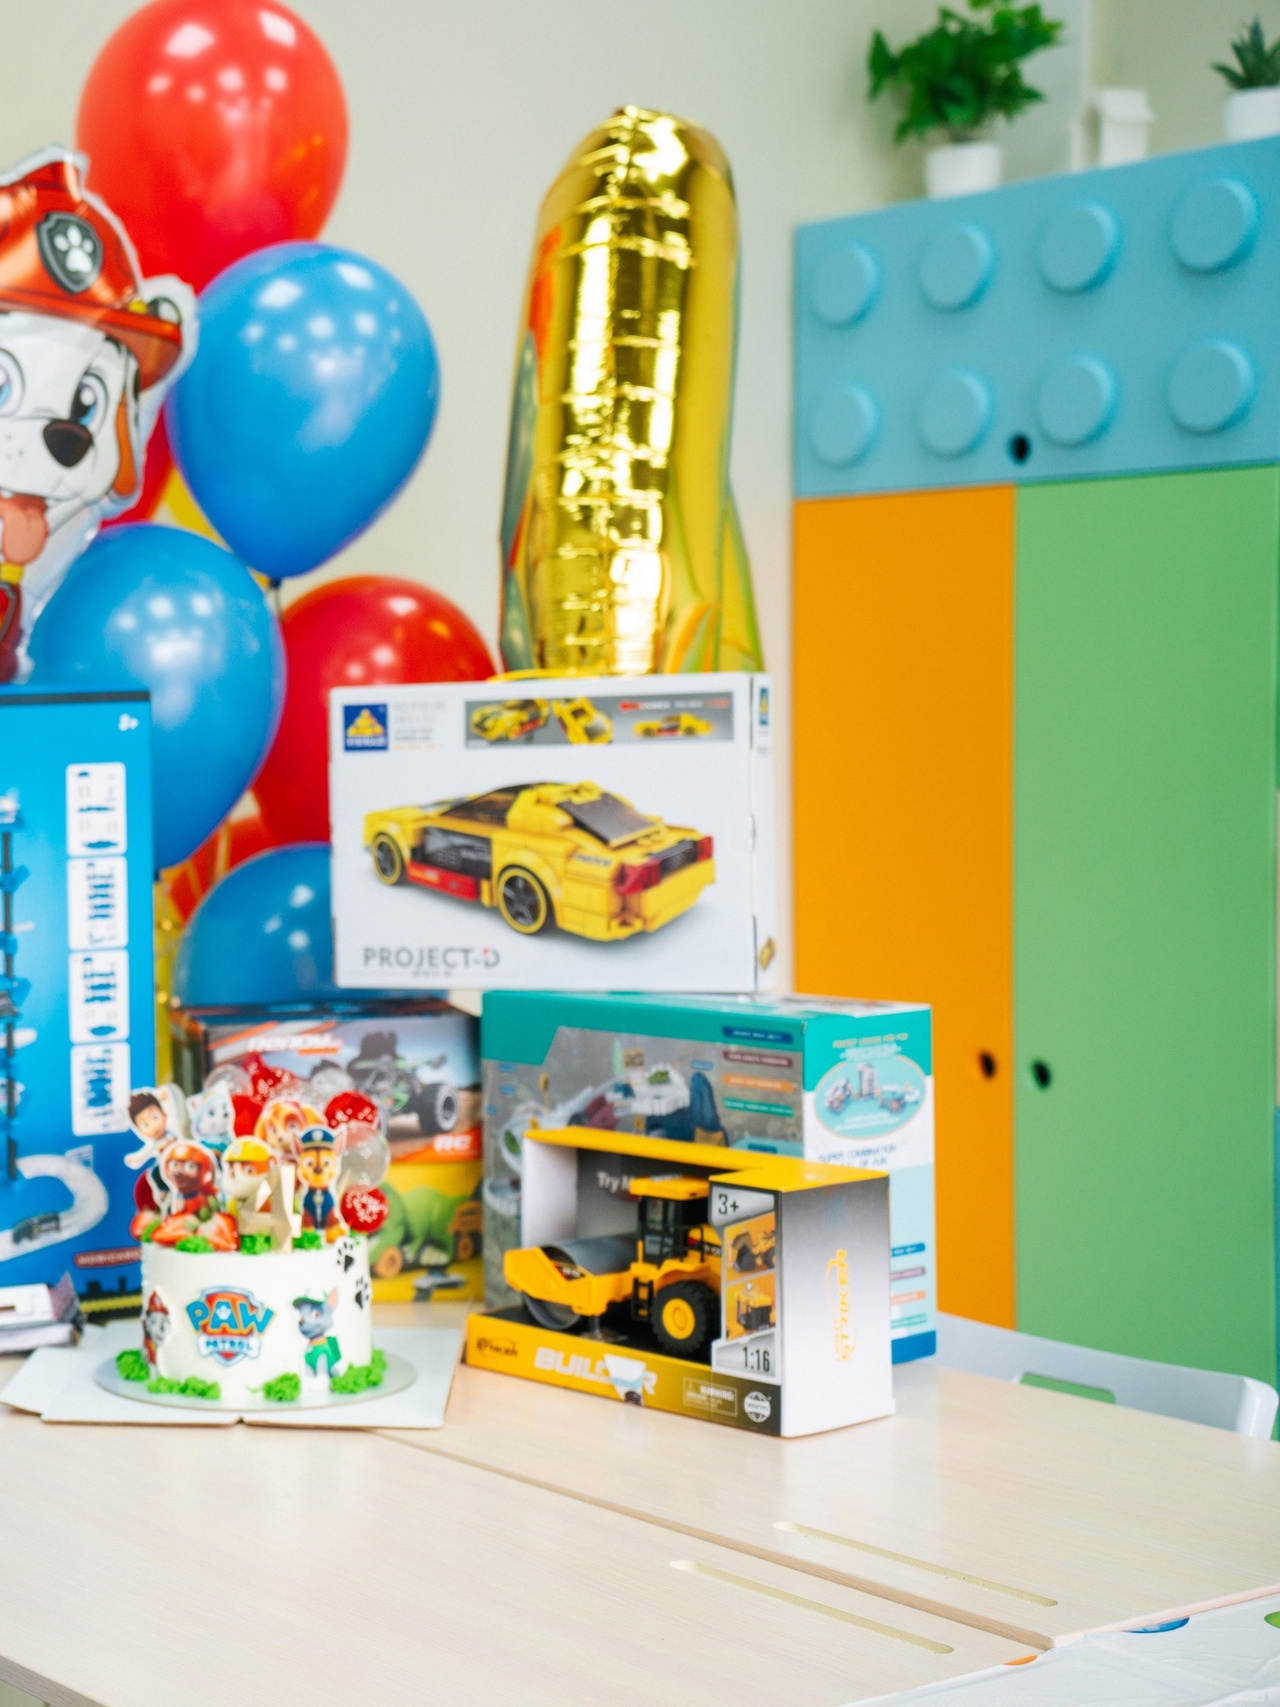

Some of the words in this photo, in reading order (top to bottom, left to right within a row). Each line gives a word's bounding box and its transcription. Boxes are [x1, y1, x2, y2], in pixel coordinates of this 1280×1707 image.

[362, 946, 501, 969] PROJECT-D
[596, 1171, 619, 1193] Try
[717, 1194, 740, 1215] 3+
[184, 1299, 275, 1335] PAW
[205, 1339, 255, 1352] PATROL
[742, 1346, 770, 1374] 1:16
